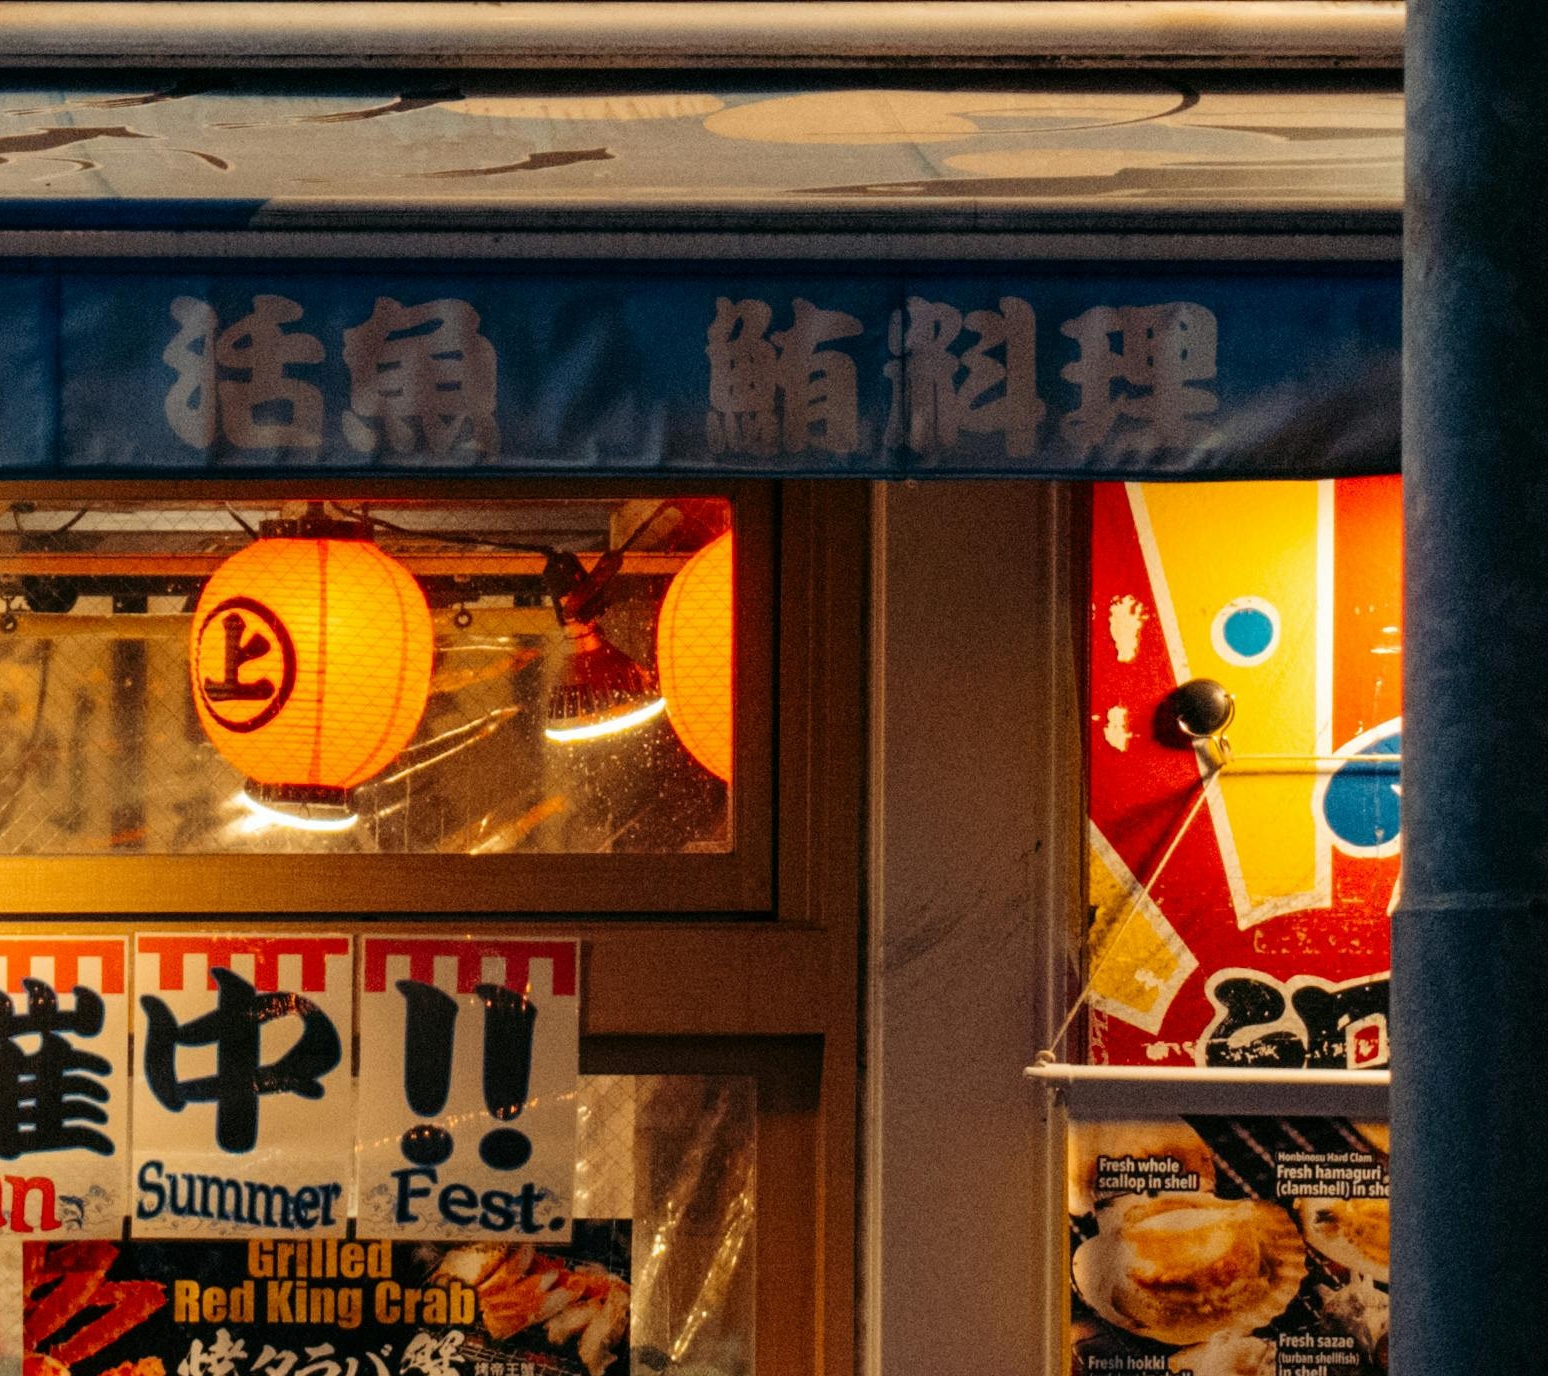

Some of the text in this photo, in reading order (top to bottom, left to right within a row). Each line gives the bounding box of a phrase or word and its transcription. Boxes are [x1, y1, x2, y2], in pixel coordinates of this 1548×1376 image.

[162, 293, 500, 455] 活魚
[706, 293, 1219, 456] 鮪料理
[203, 614, 275, 703] 上
[1099, 1158, 1179, 1174] Fresh whole
[1328, 1152, 1372, 1162] Hard Clam
[1098, 1174, 1198, 1192] scallop in shell
[1277, 1165, 1381, 1183] Fresh hamaguri
[137, 1159, 346, 1234] Summer
[394, 1170, 565, 1234] Fest.
[1276, 1181, 1350, 1198] (clamshell)
[248, 1240, 392, 1278] Grilled
[174, 1279, 476, 1330] Red King Crab
[1279, 1333, 1354, 1348] Fresh sazae
[1089, 1356, 1165, 1370] Fresh hokki
[1278, 1352, 1359, 1366] (turban shellfish)
